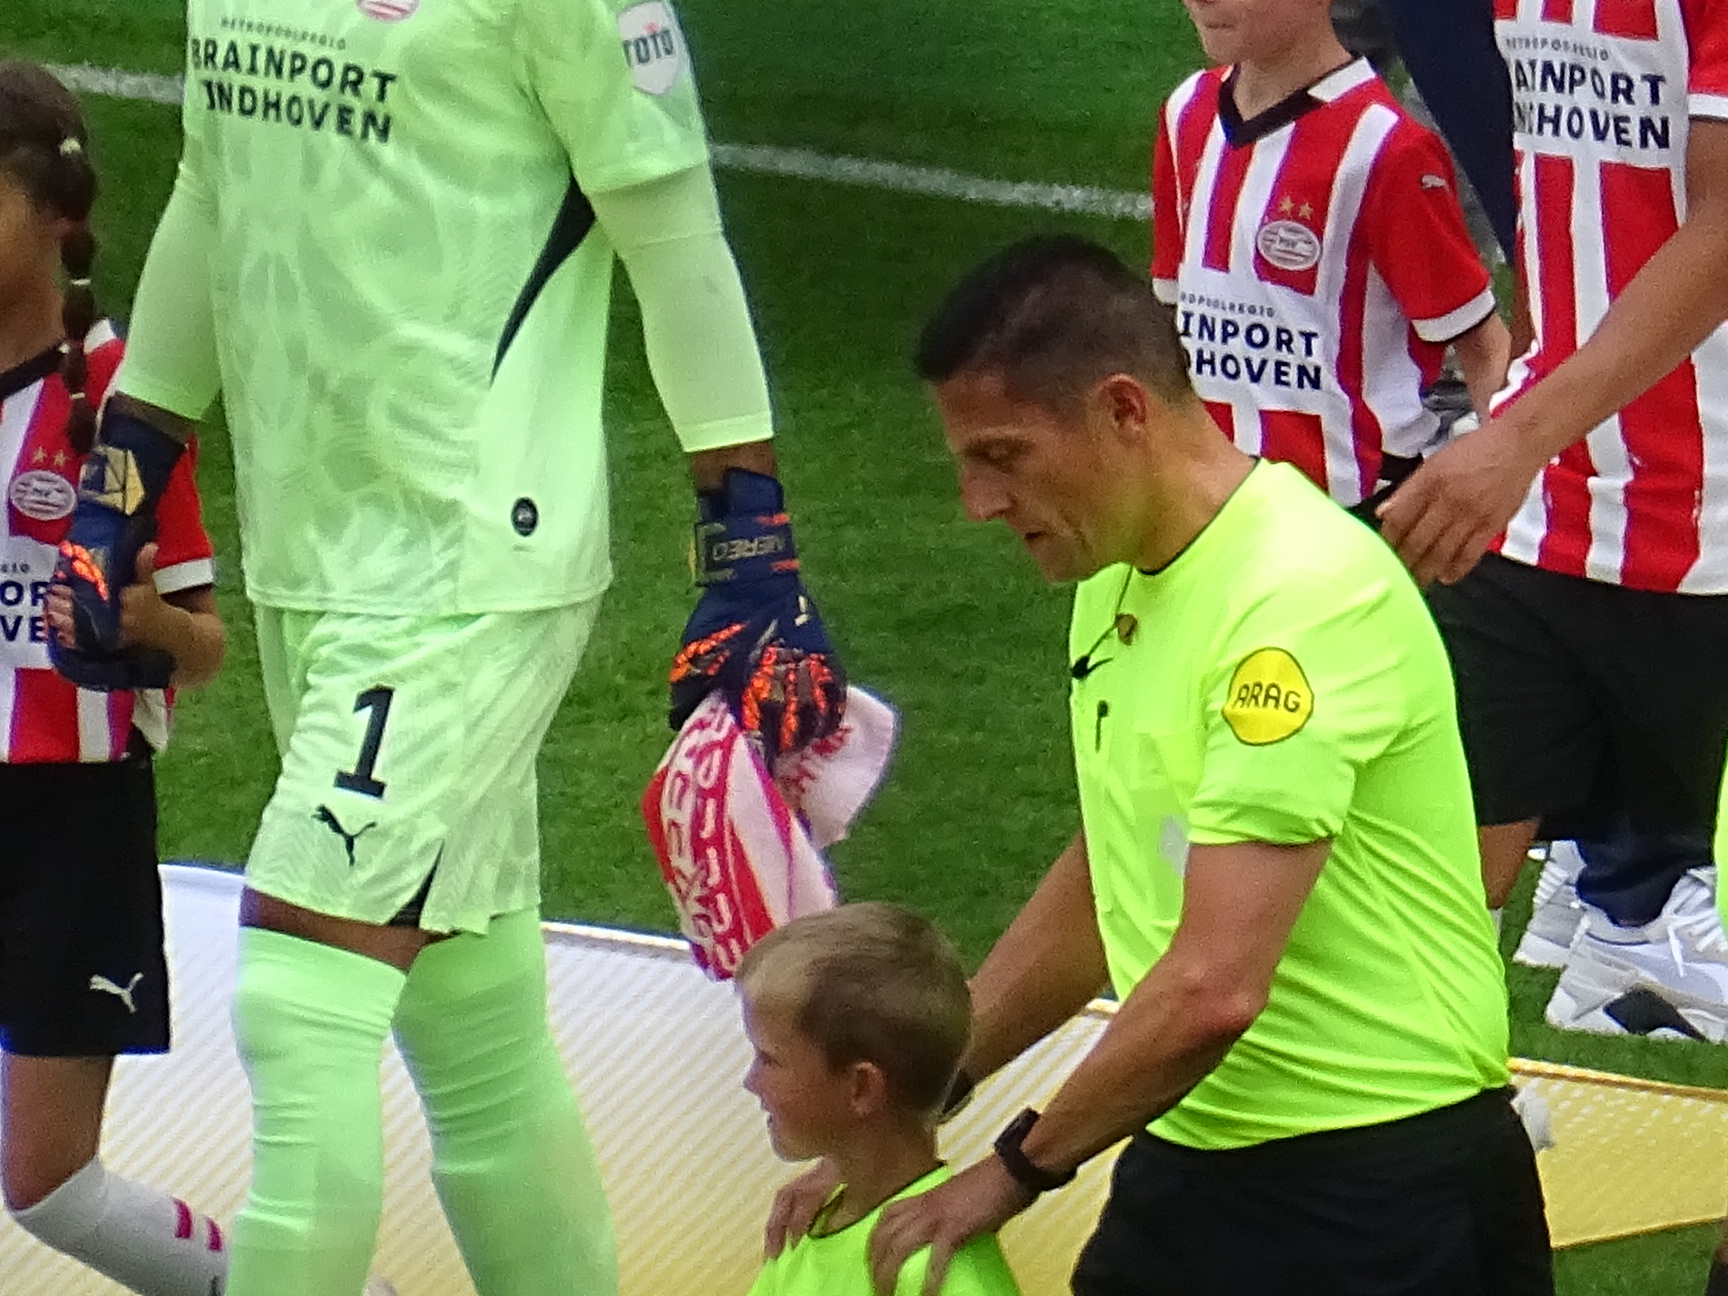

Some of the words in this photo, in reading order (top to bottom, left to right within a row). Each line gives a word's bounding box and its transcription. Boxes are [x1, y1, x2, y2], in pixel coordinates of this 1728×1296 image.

[203, 79, 392, 144] INDHOVEN
[1231, 679, 1306, 715] ARAG
[334, 684, 395, 802] 1
